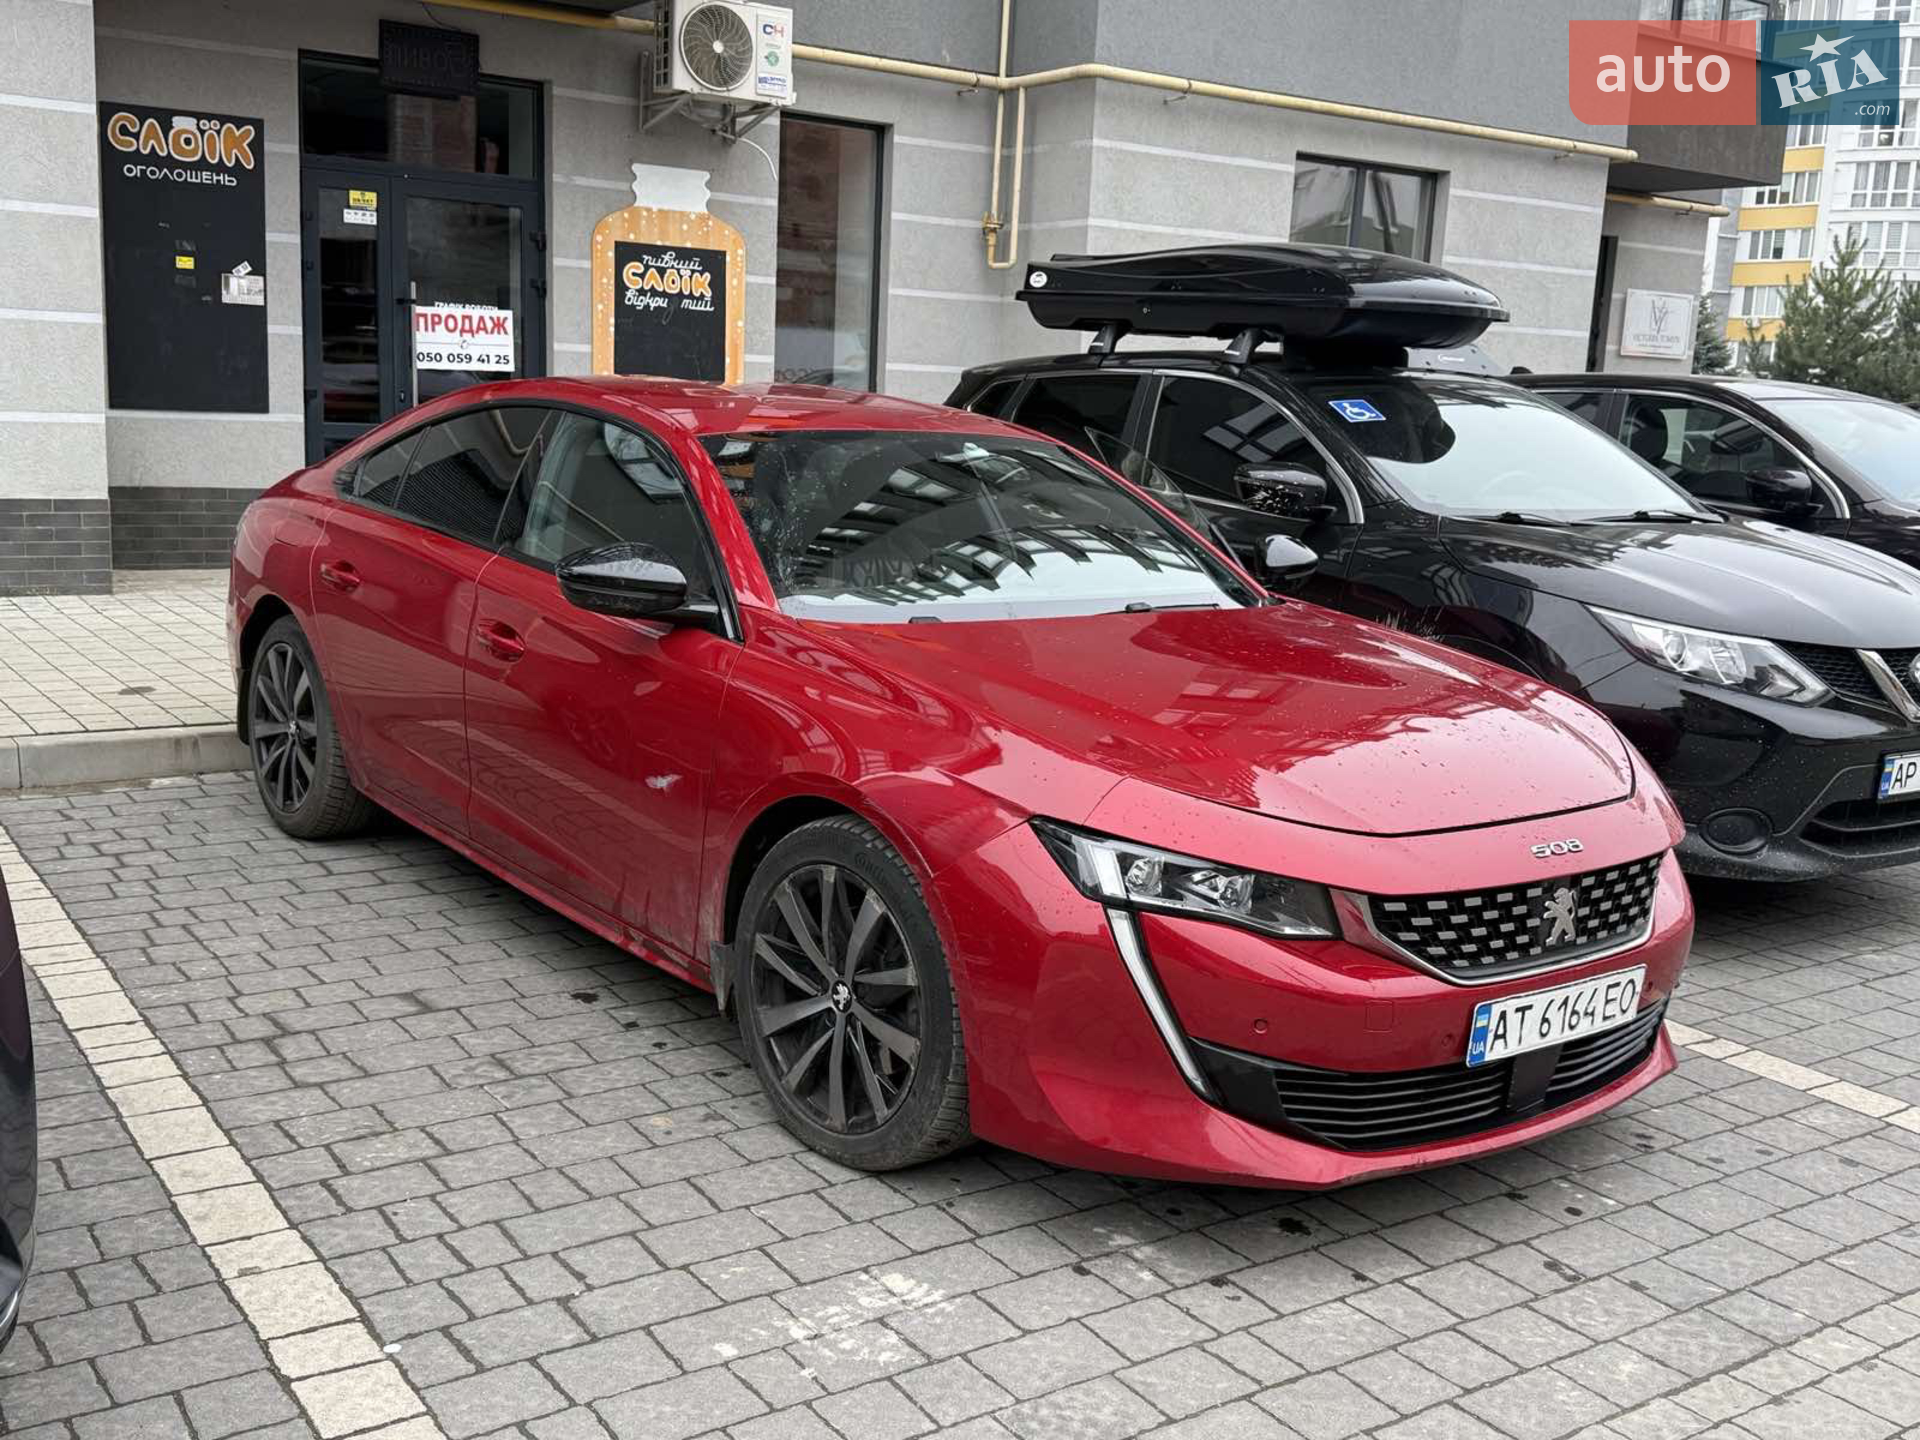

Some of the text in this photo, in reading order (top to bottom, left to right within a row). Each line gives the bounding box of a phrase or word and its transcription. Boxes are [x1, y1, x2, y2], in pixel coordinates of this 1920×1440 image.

[763, 24, 784, 38] CH
[107, 112, 255, 170] СЛОЇК
[123, 164, 238, 187] ОГОЛОШЕНЬ
[623, 261, 712, 297] СЛОЇК
[415, 313, 508, 338] ПРОДАЖ
[416, 352, 510, 365] 050 059 41 25
[1891, 762, 1918, 789] AP
[1530, 839, 1584, 857] 508
[1489, 1004, 1533, 1053] AT
[1539, 987, 1599, 1040] 6164
[1472, 1041, 1485, 1055] UA
